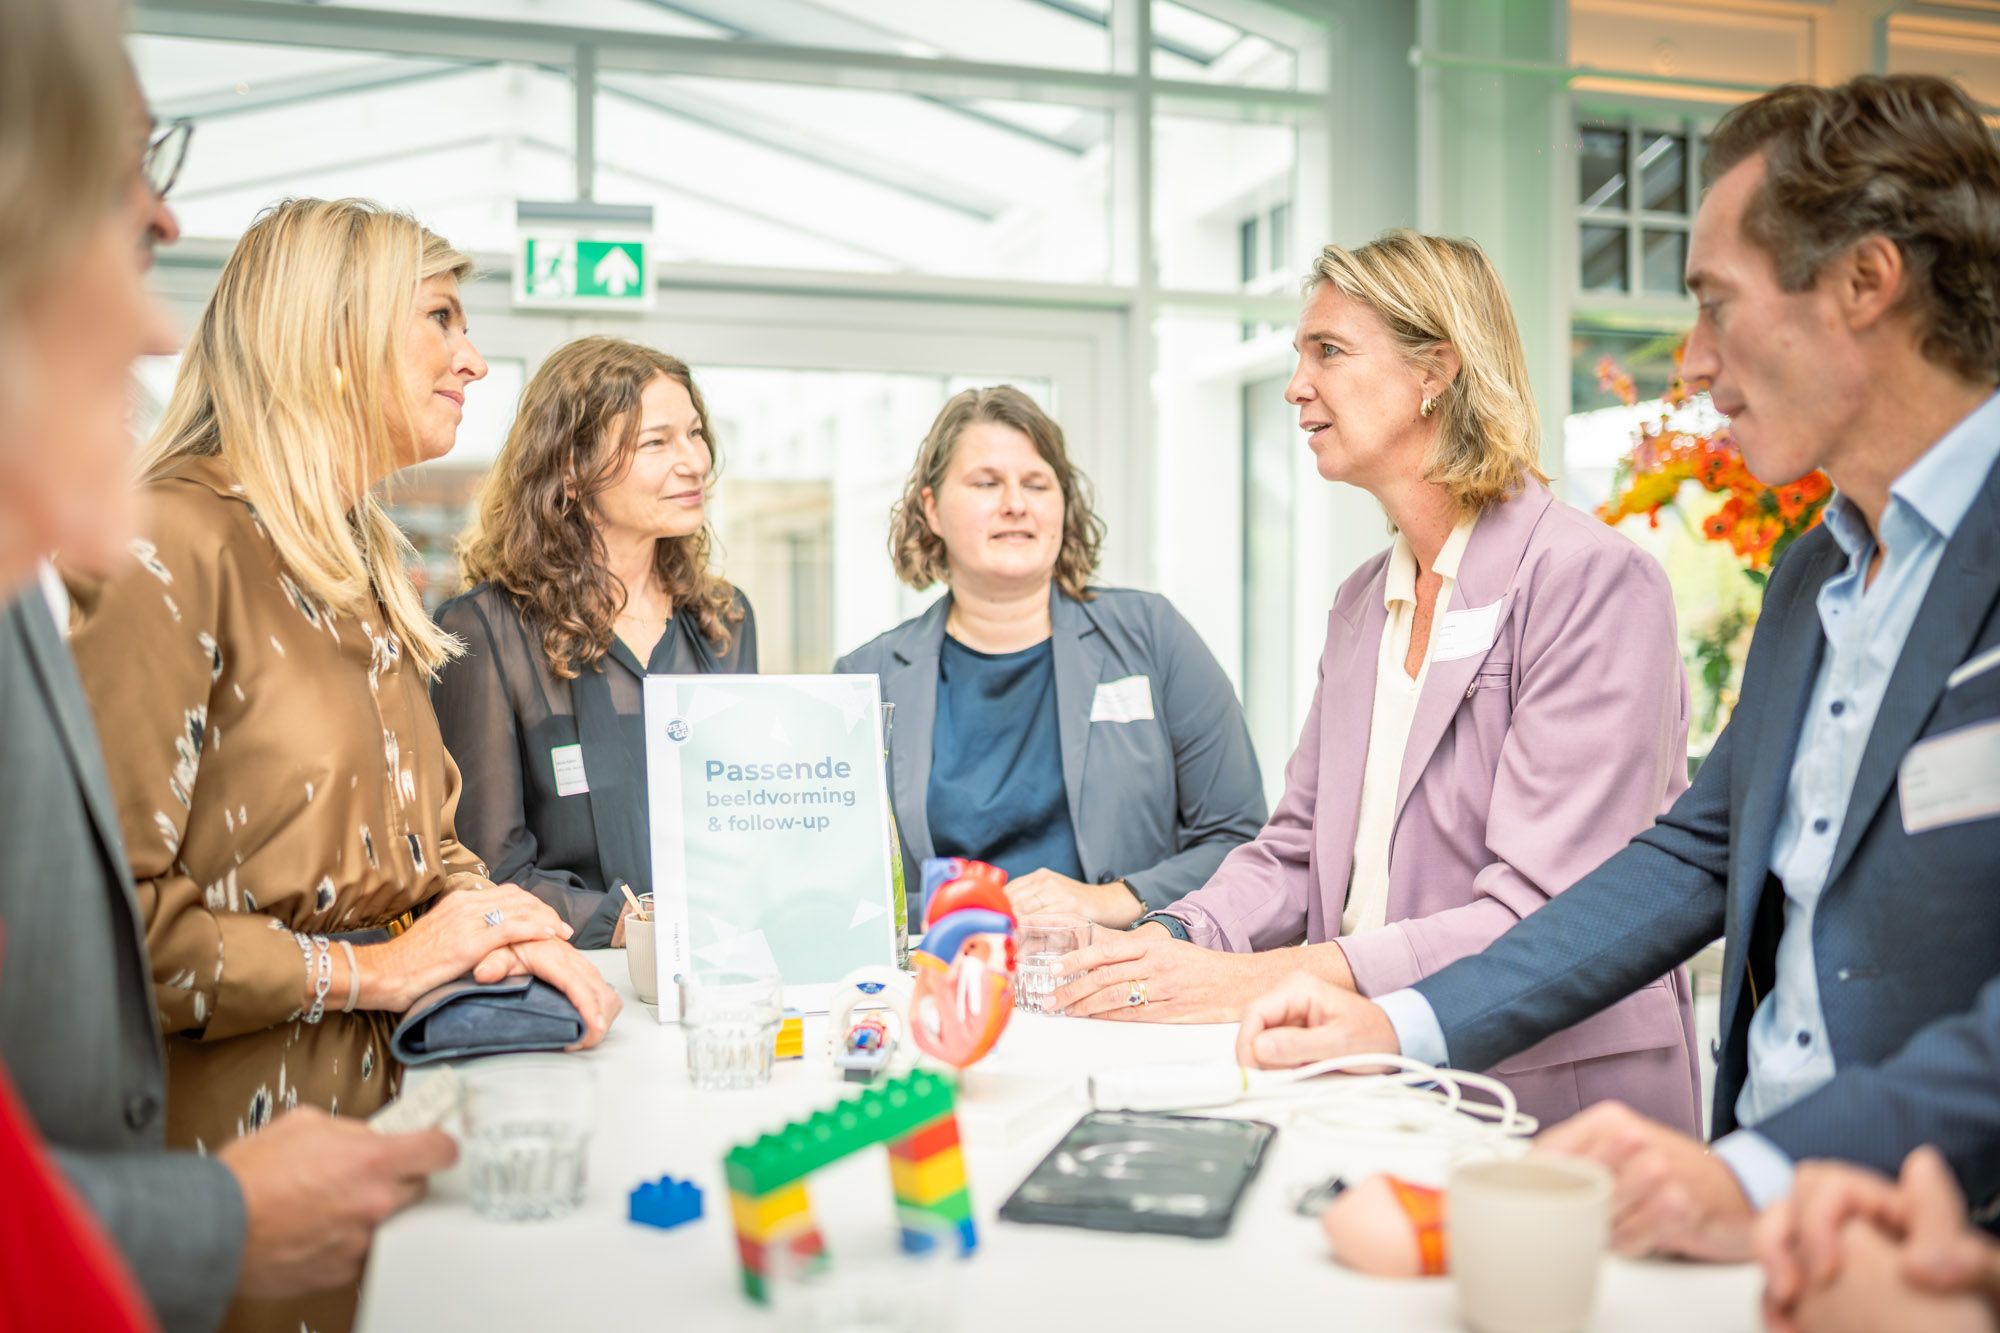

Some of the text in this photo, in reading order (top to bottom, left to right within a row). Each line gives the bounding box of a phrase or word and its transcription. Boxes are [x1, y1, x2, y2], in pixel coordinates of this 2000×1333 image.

[705, 756, 851, 782] Passende
[706, 786, 855, 807] beeldvorming
[708, 814, 830, 833] & follow-up
